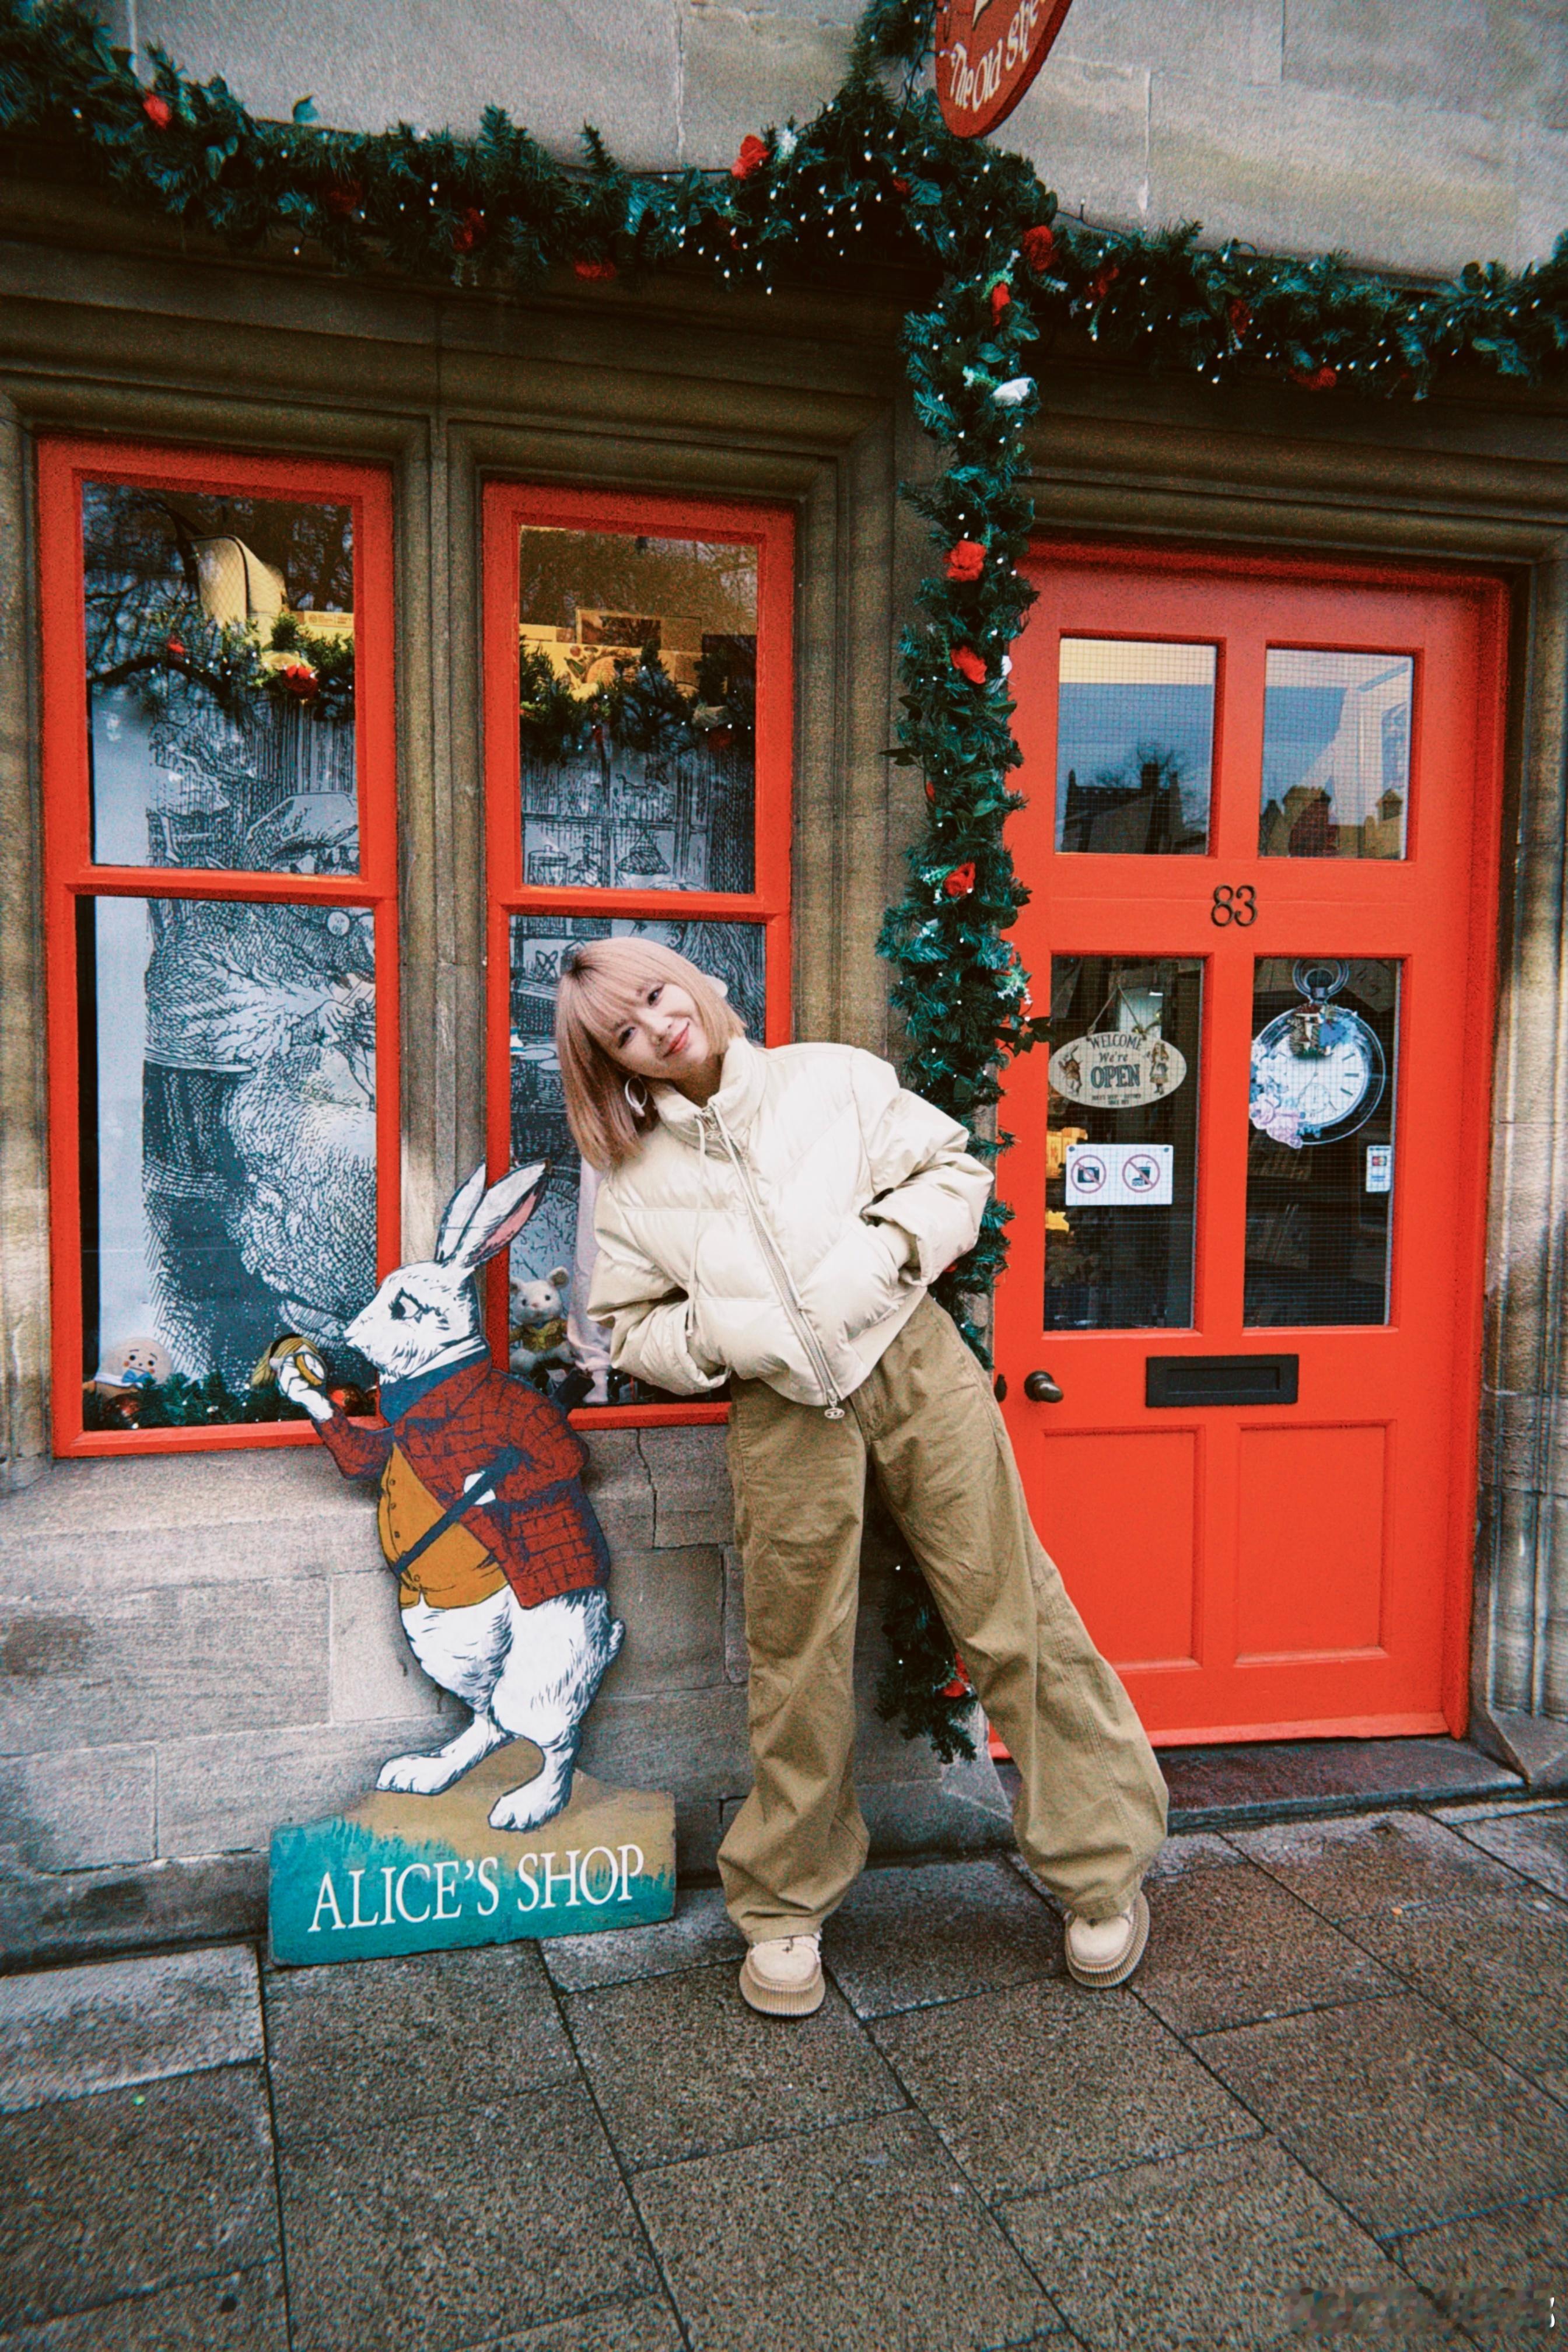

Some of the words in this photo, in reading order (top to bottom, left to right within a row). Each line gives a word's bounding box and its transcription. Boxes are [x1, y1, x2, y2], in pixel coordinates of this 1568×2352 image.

[950, 43, 974, 110] The
[972, 38, 1002, 112] Old
[1211, 885, 1257, 927] 83
[1091, 1034, 1142, 1050] WELCOME
[1099, 1051, 1128, 1062] We're
[1091, 1064, 1140, 1089] OPEN
[308, 1857, 499, 1932] ALICE'S
[517, 1845, 644, 1912] SHOP
